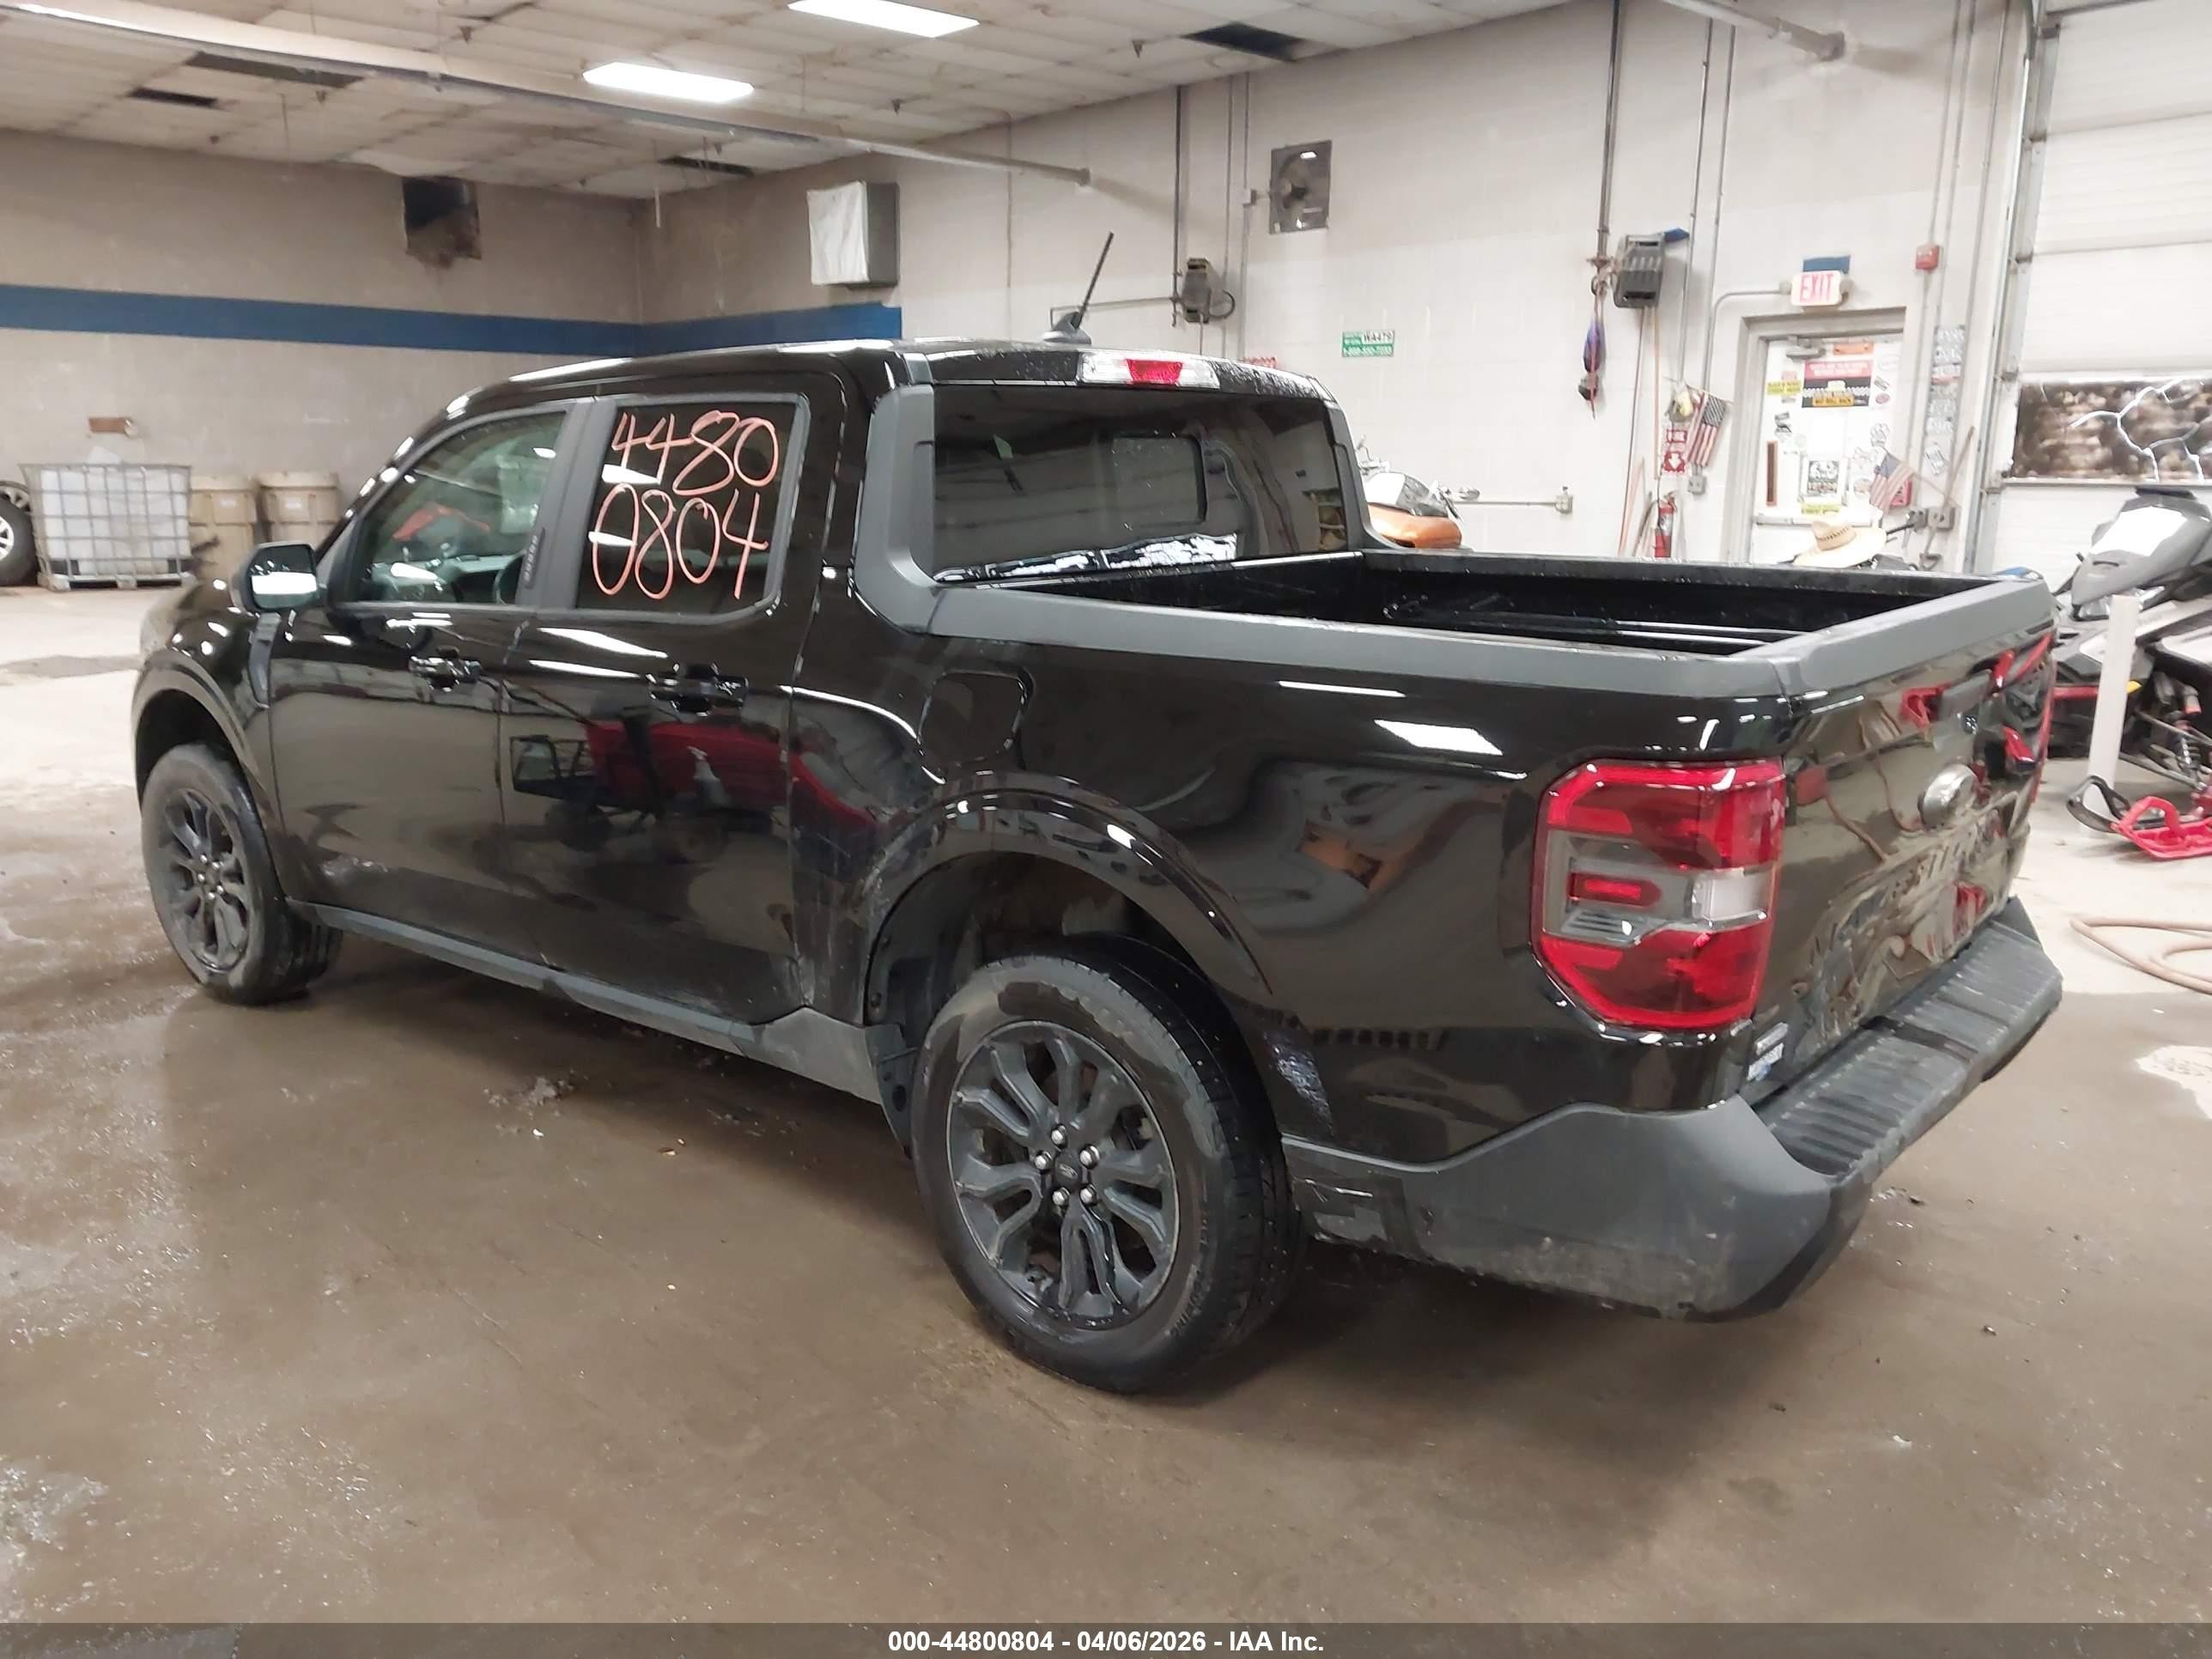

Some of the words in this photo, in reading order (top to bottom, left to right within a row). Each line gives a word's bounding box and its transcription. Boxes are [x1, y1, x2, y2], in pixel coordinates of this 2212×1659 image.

[1799, 273, 1834, 301] EXIT
[611, 410, 779, 496] 4480
[592, 482, 769, 600] 0804
